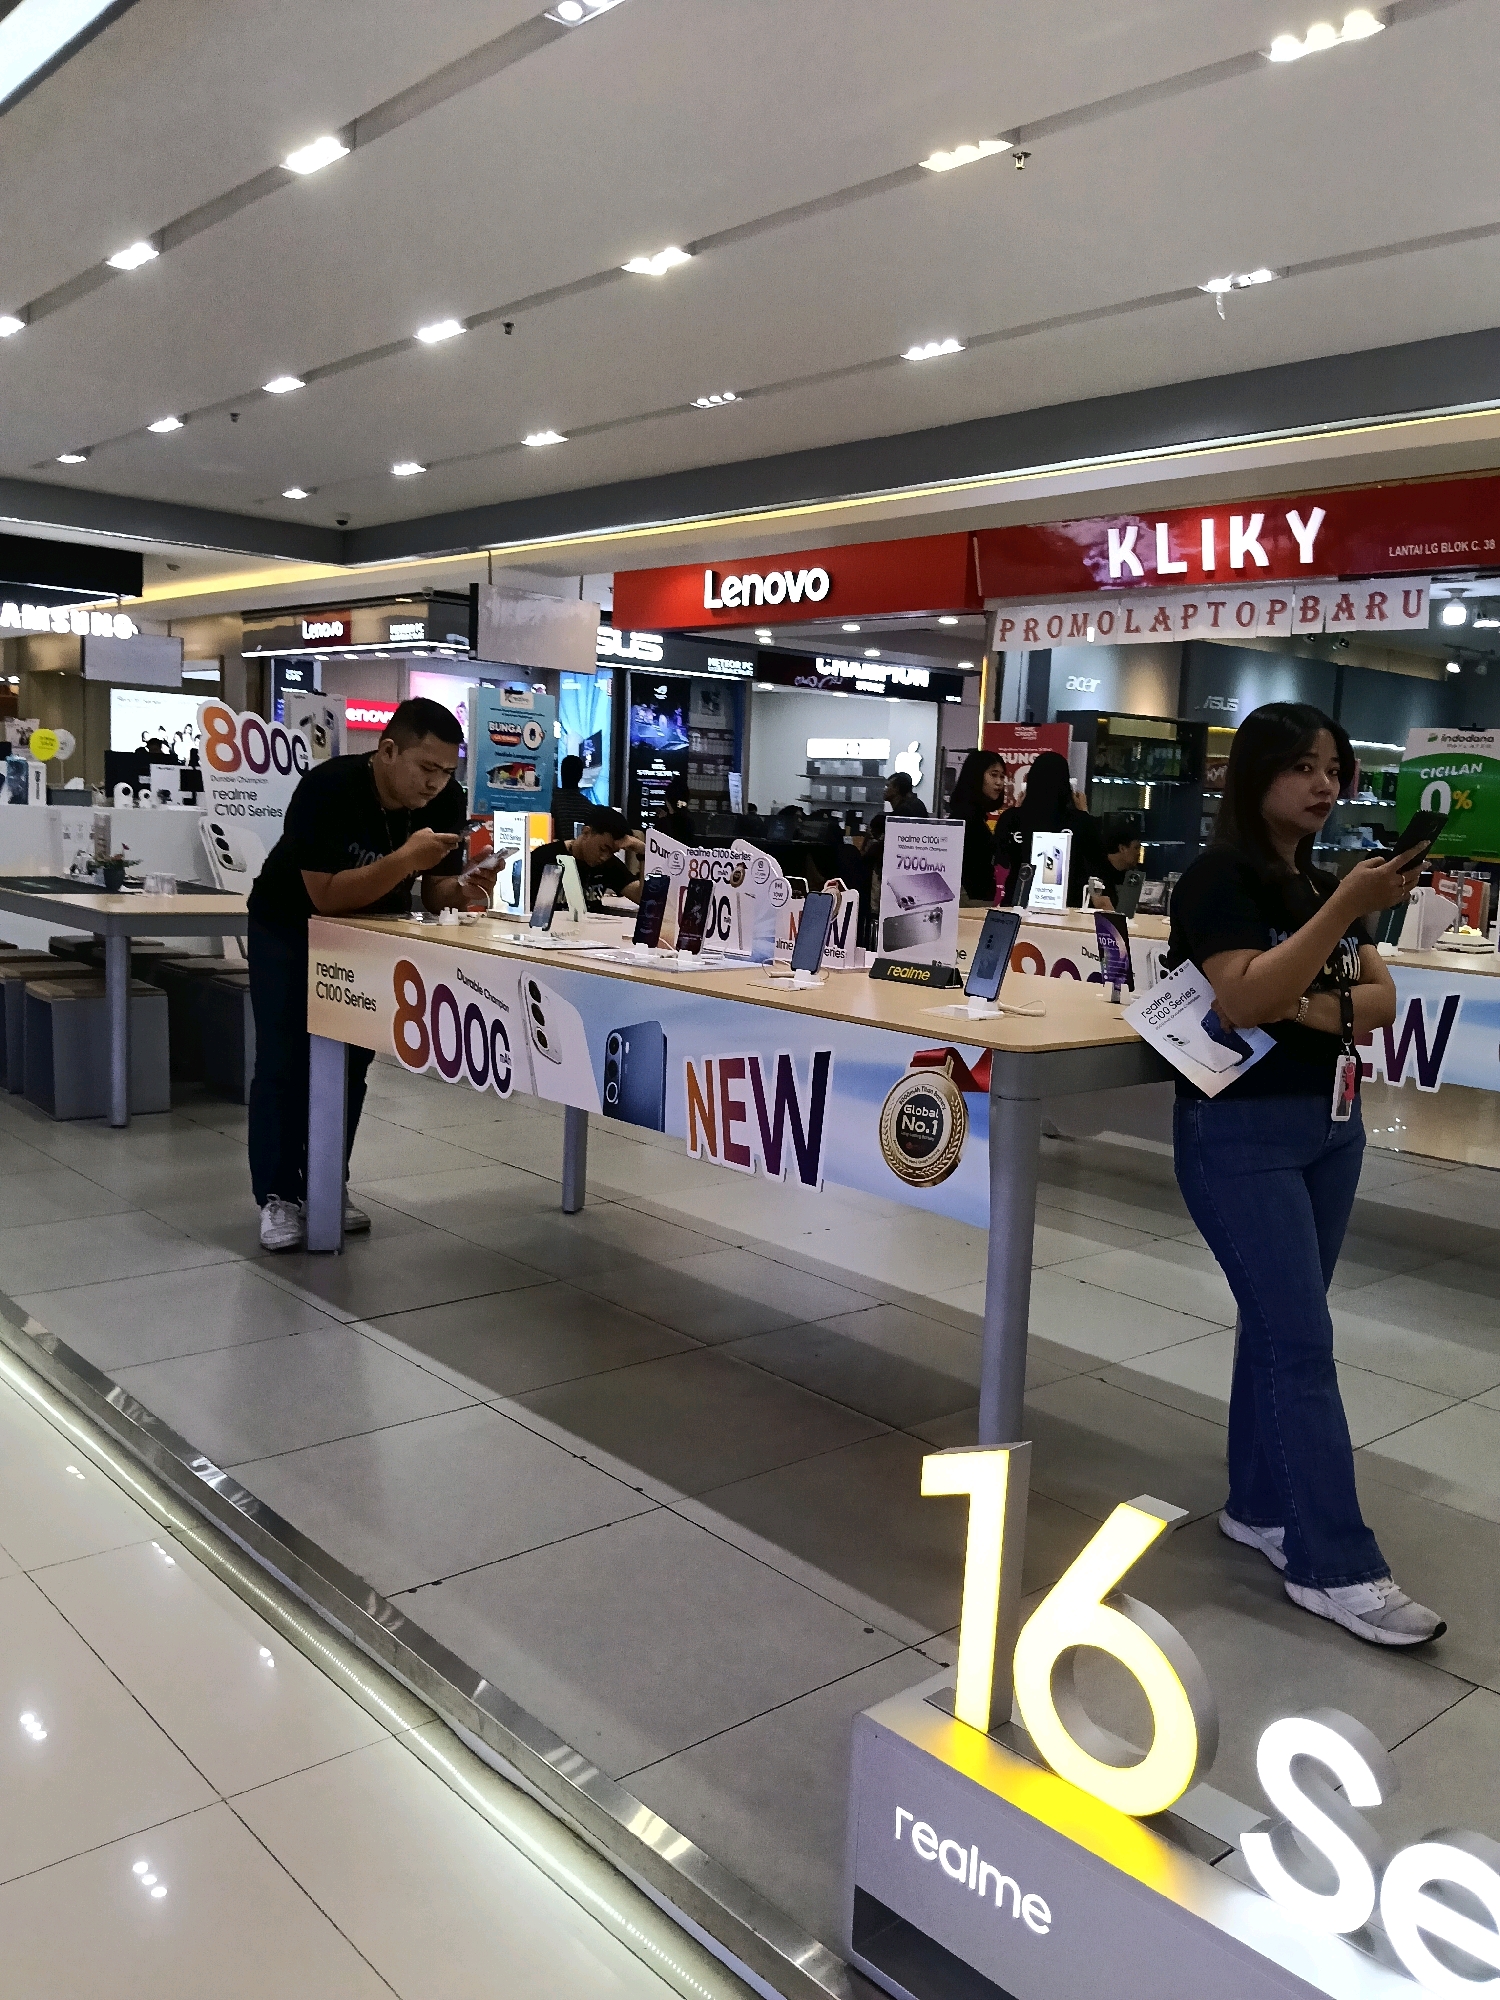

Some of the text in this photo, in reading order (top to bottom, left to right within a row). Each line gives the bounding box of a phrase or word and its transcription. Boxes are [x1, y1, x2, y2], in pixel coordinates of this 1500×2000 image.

[1106, 507, 1327, 579] KLIKY
[1388, 544, 1423, 556] LANTAI
[1424, 543, 1439, 555] LG
[1440, 541, 1469, 553] BLOK
[703, 567, 831, 610] Lenovo
[302, 620, 344, 639] Lenovo
[1066, 675, 1101, 692] acer
[1203, 695, 1239, 712] ASUS
[488, 721, 522, 734] BUNGA
[1440, 733, 1495, 742] indodana
[1420, 762, 1484, 779] CICILAN
[212, 788, 258, 801] realme
[214, 803, 284, 817] C100 Series
[898, 835, 921, 843] realme
[686, 848, 752, 861] realme C100 Series
[896, 854, 946, 873] 7000mAh
[316, 961, 355, 983] realme
[886, 965, 931, 981] realme
[316, 980, 377, 1012] C100 Series
[456, 967, 510, 1014] Durable Champion
[1140, 991, 1172, 1019] realme
[1148, 987, 1197, 1025] C100 Series
[686, 1051, 831, 1187] NEW
[903, 1104, 939, 1119] Global
[901, 1114, 939, 1136] No.1
[920, 1450, 1197, 1817] 16
[895, 1805, 1053, 1935] realme
